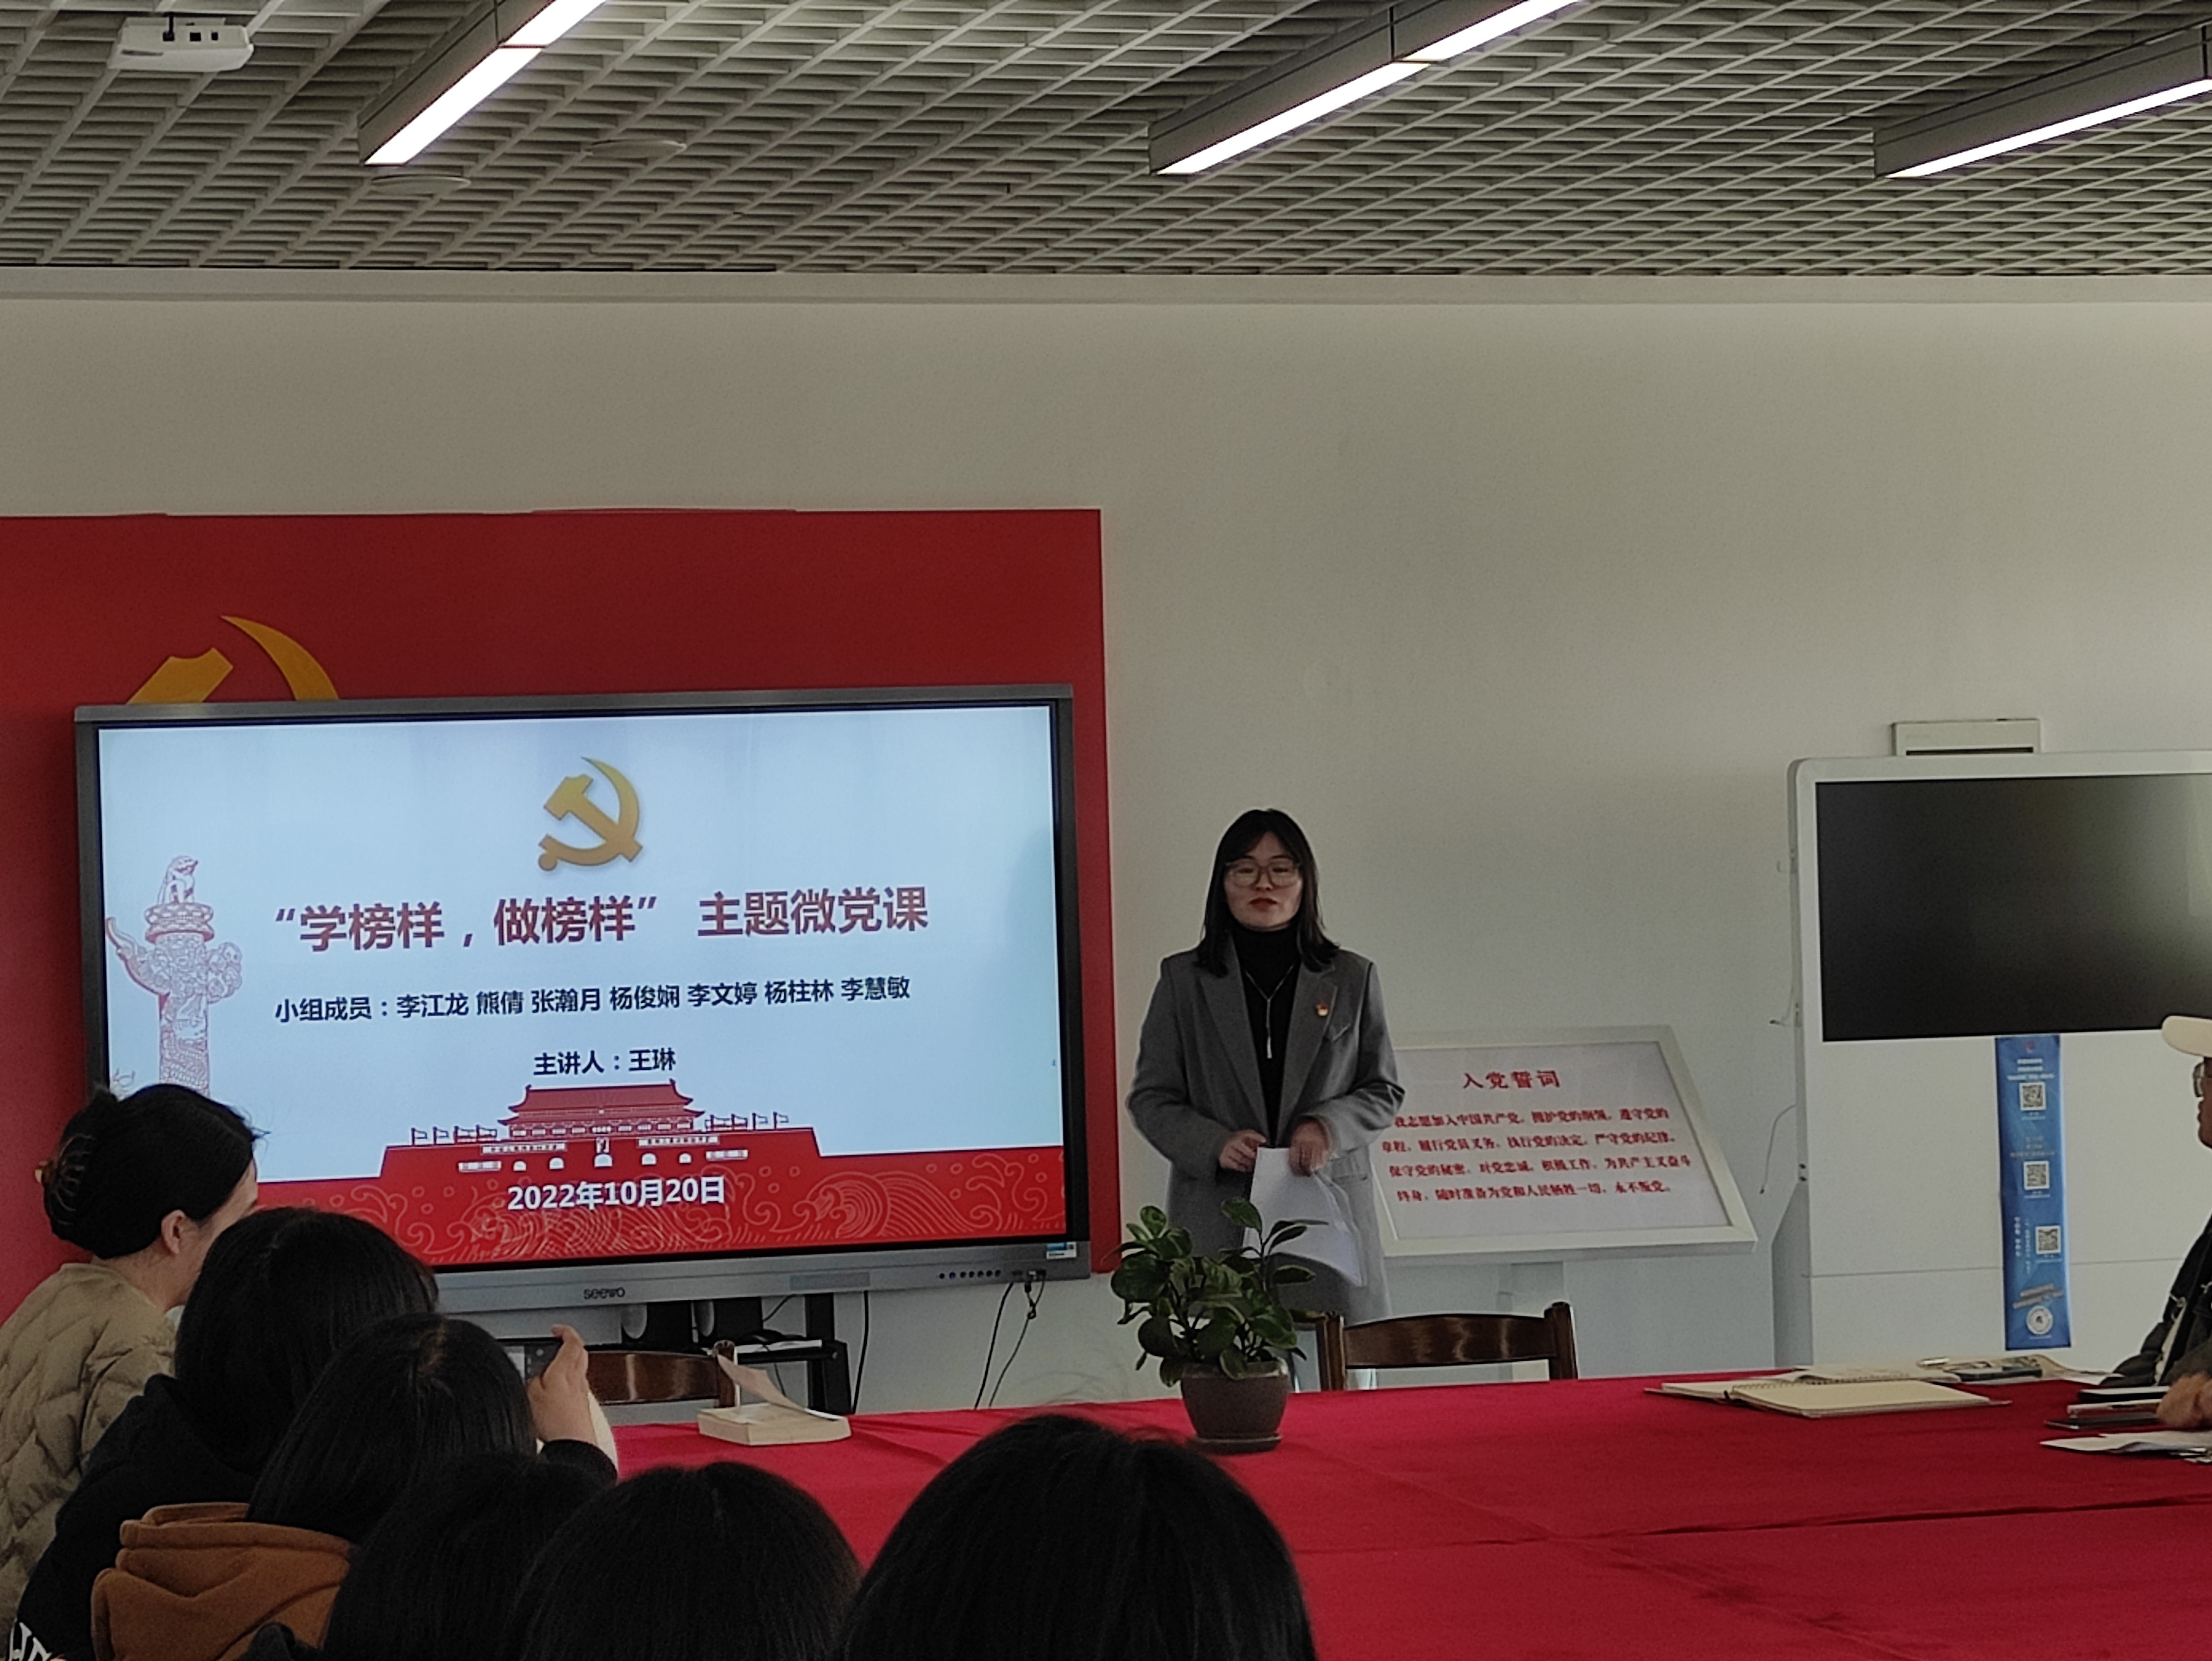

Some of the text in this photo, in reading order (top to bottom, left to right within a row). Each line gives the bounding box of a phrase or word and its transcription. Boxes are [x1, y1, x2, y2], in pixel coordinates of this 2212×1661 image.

[697, 886, 929, 937] 主题微党课
[476, 990, 524, 1015] 熊倩
[531, 988, 601, 1013] 张瀚月
[687, 982, 758, 1008] 李文婷
[764, 979, 834, 1005] 杨柱林
[841, 975, 910, 1002] 李慧敏
[1462, 1069, 1561, 1090] 入党誓词
[507, 1175, 725, 1211] 2022年10月20日
